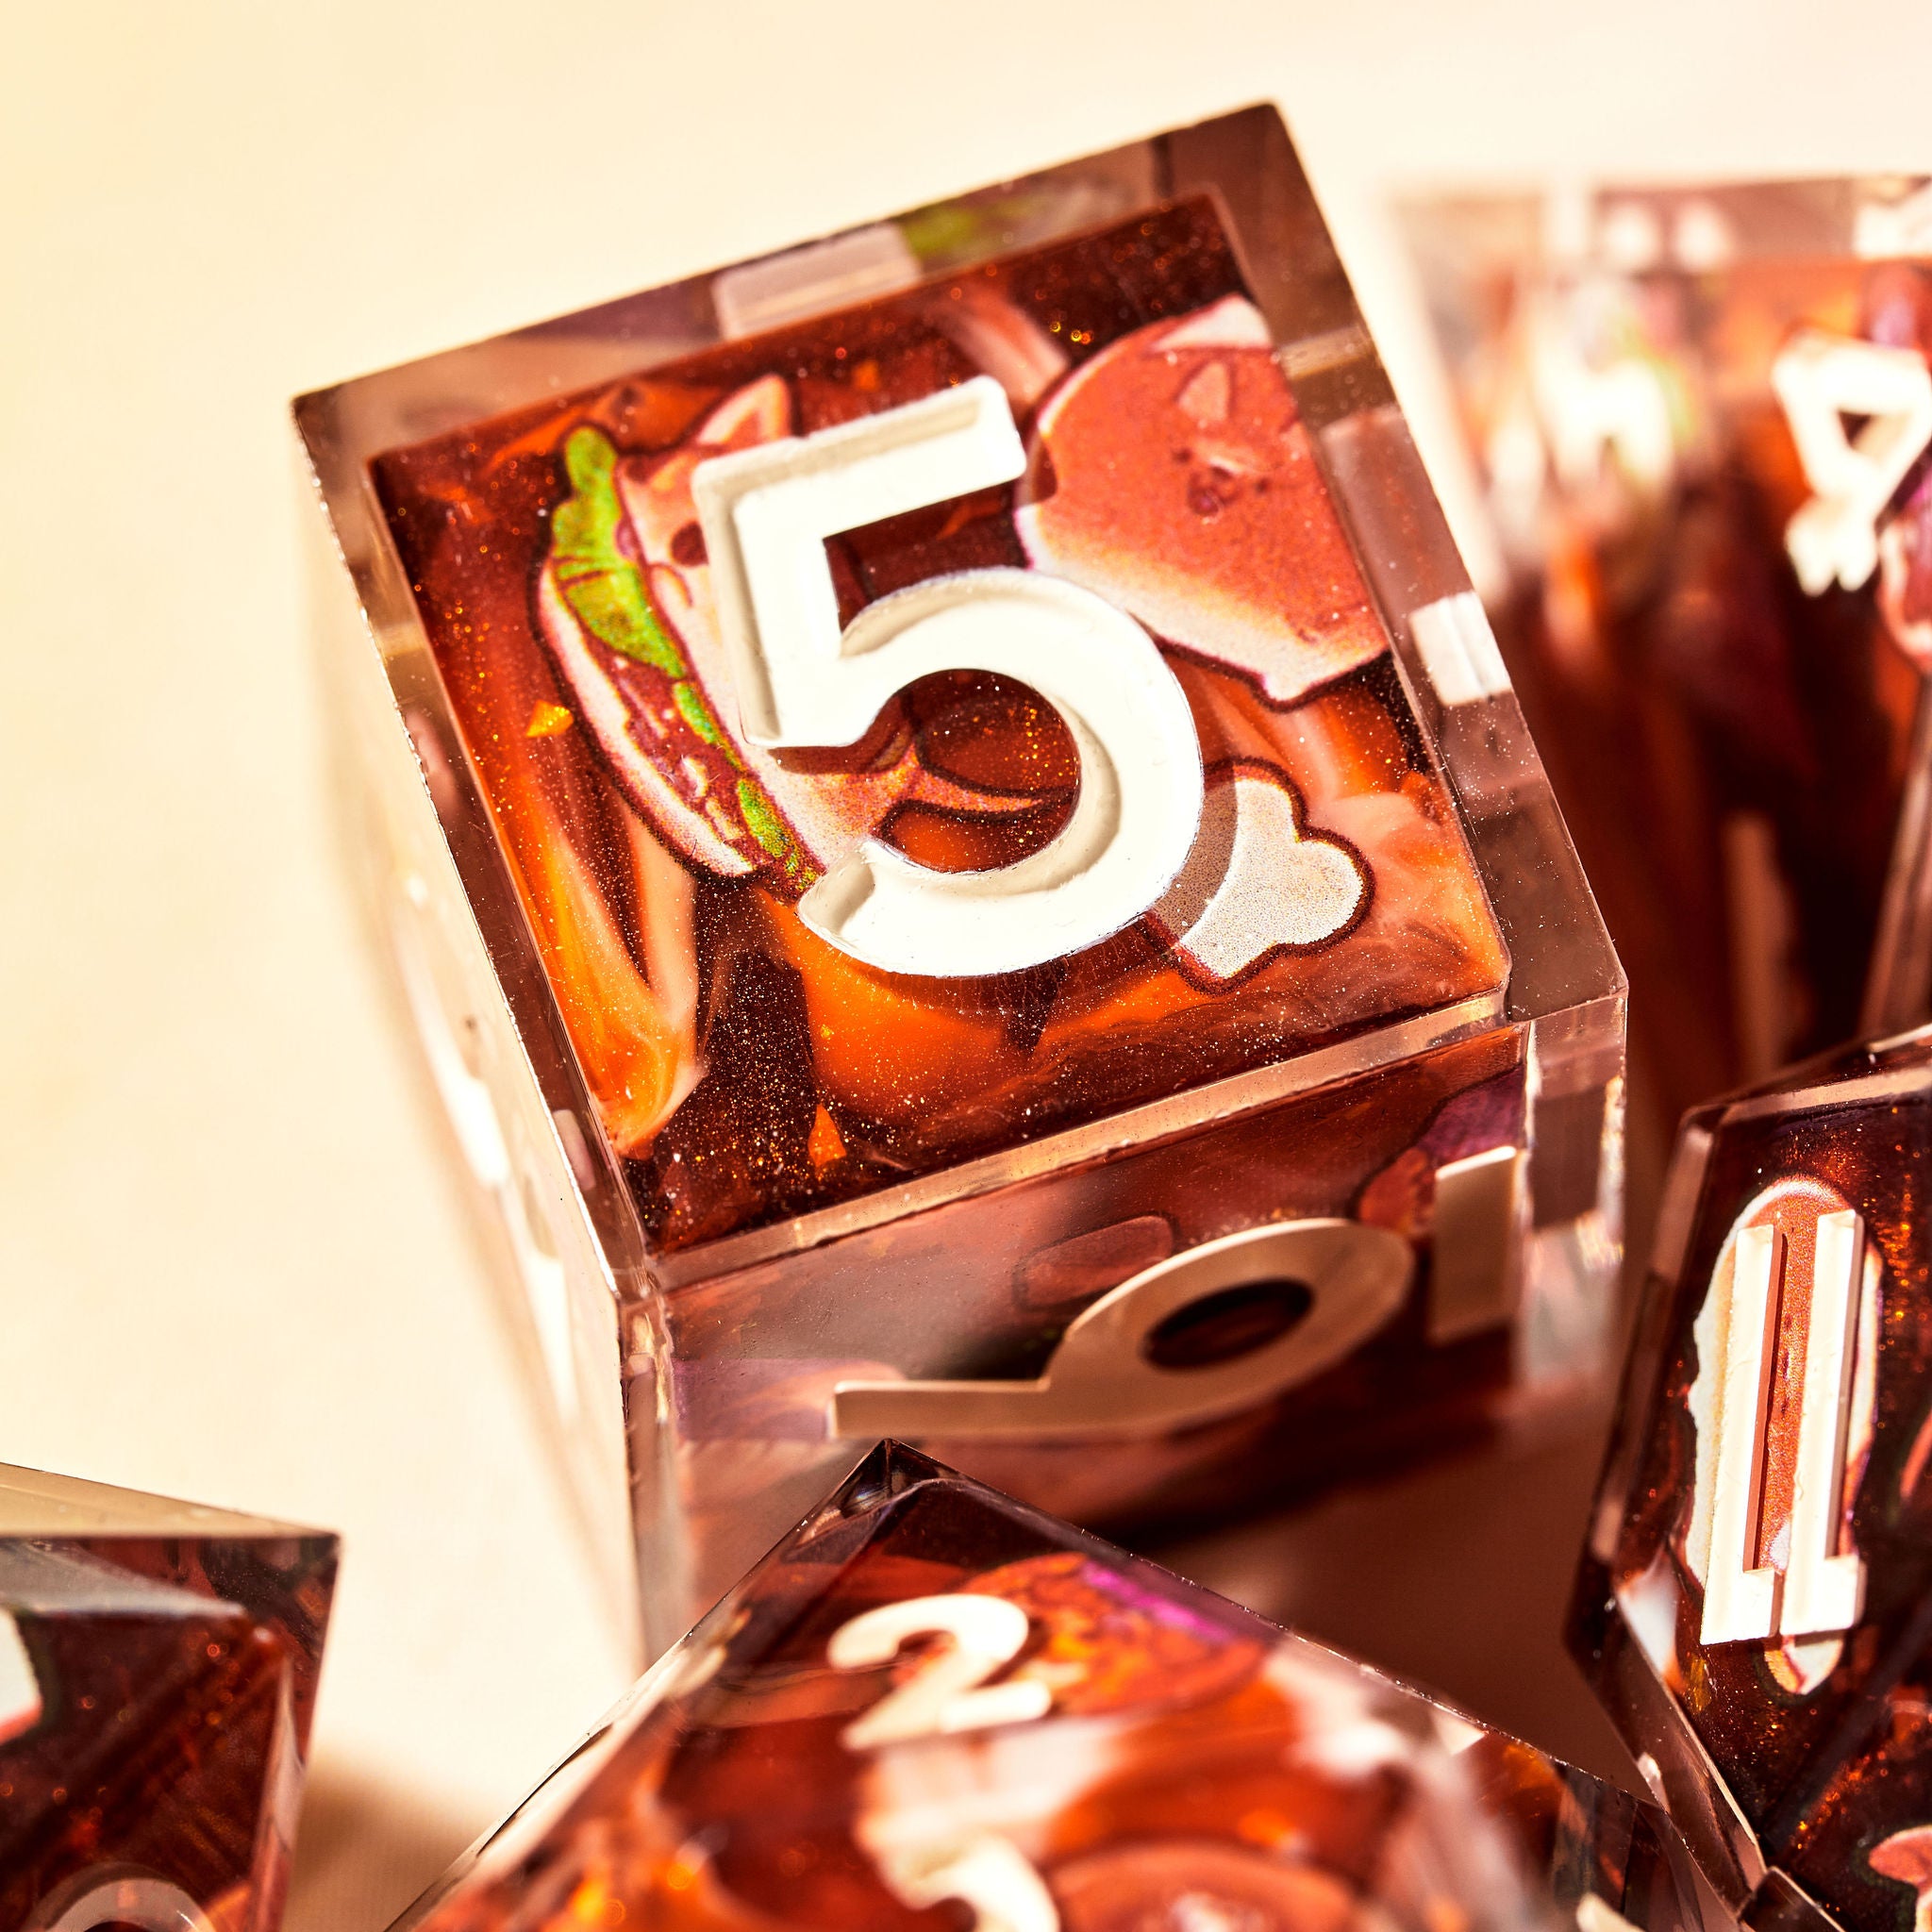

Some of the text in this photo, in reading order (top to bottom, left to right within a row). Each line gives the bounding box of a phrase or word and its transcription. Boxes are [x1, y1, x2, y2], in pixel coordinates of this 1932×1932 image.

[691, 375, 1205, 978] 5
[1701, 1208, 1866, 1645] 11
[826, 1592, 1052, 1751] 2
